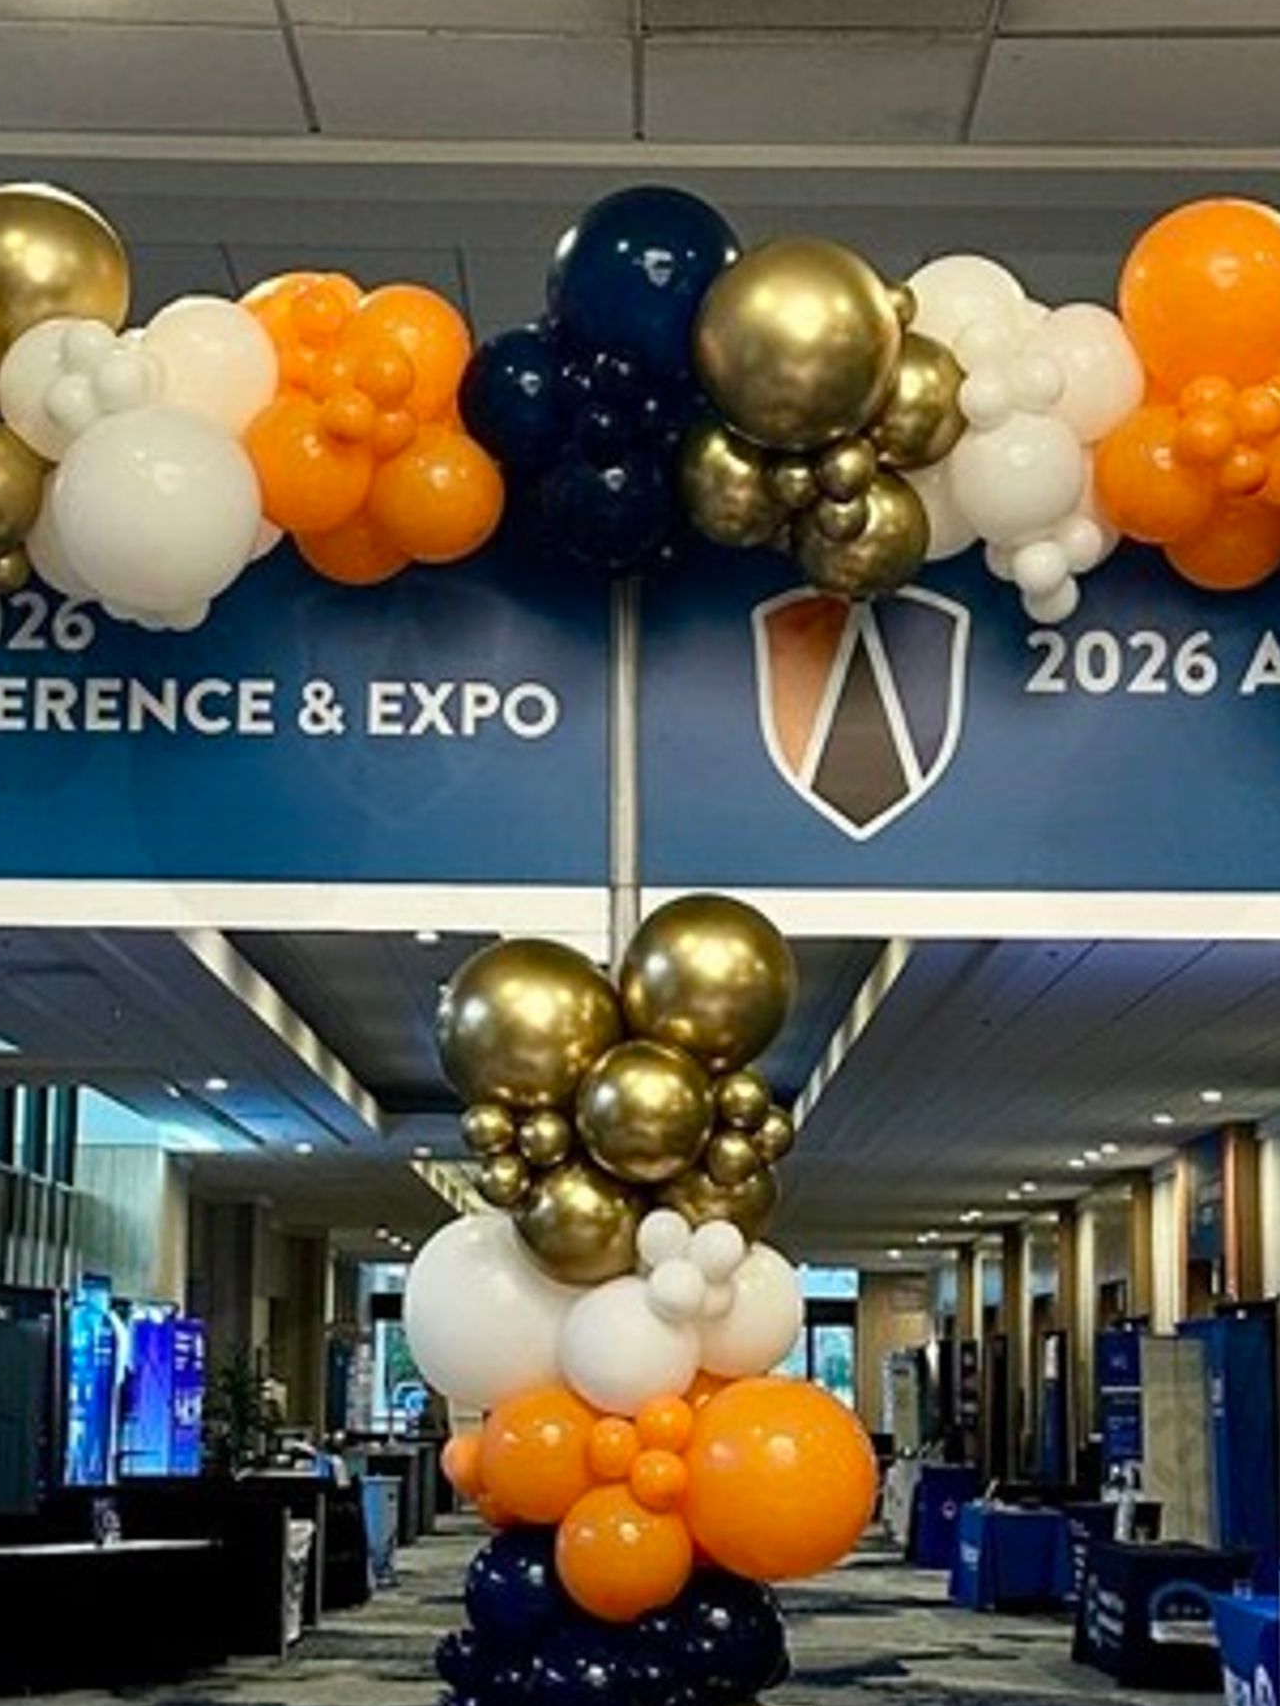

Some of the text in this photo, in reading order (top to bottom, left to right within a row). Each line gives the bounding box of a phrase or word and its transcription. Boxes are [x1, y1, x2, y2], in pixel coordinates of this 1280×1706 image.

[1026, 630, 1219, 695] 2026
[297, 680, 346, 736] &
[367, 682, 559, 739] EXPO
